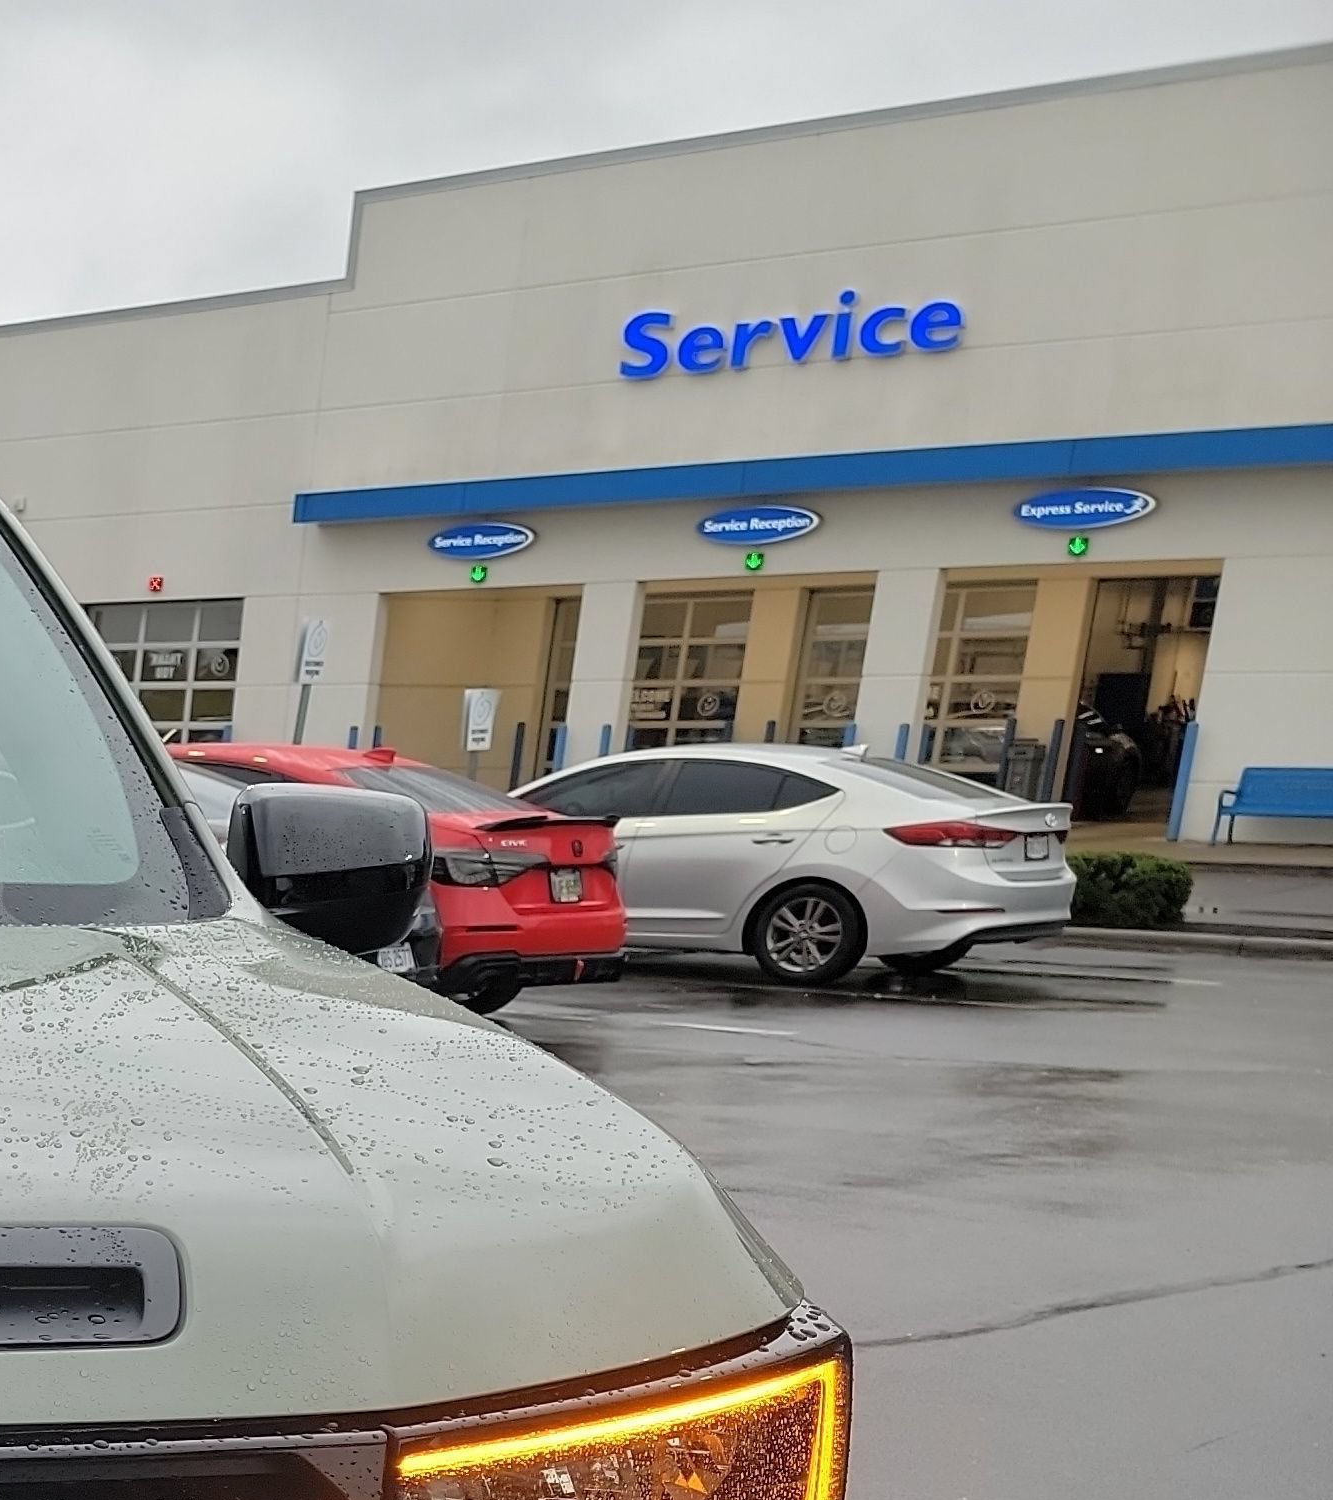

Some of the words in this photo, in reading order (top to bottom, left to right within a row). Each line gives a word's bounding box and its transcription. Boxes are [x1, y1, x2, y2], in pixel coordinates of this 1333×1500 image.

[619, 290, 965, 380] Service
[1020, 504, 1072, 518] Express
[1074, 500, 1125, 515] Service
[703, 519, 749, 534] Service
[750, 515, 811, 532] Reception
[434, 535, 473, 549] Service
[474, 531, 527, 547] Reception
